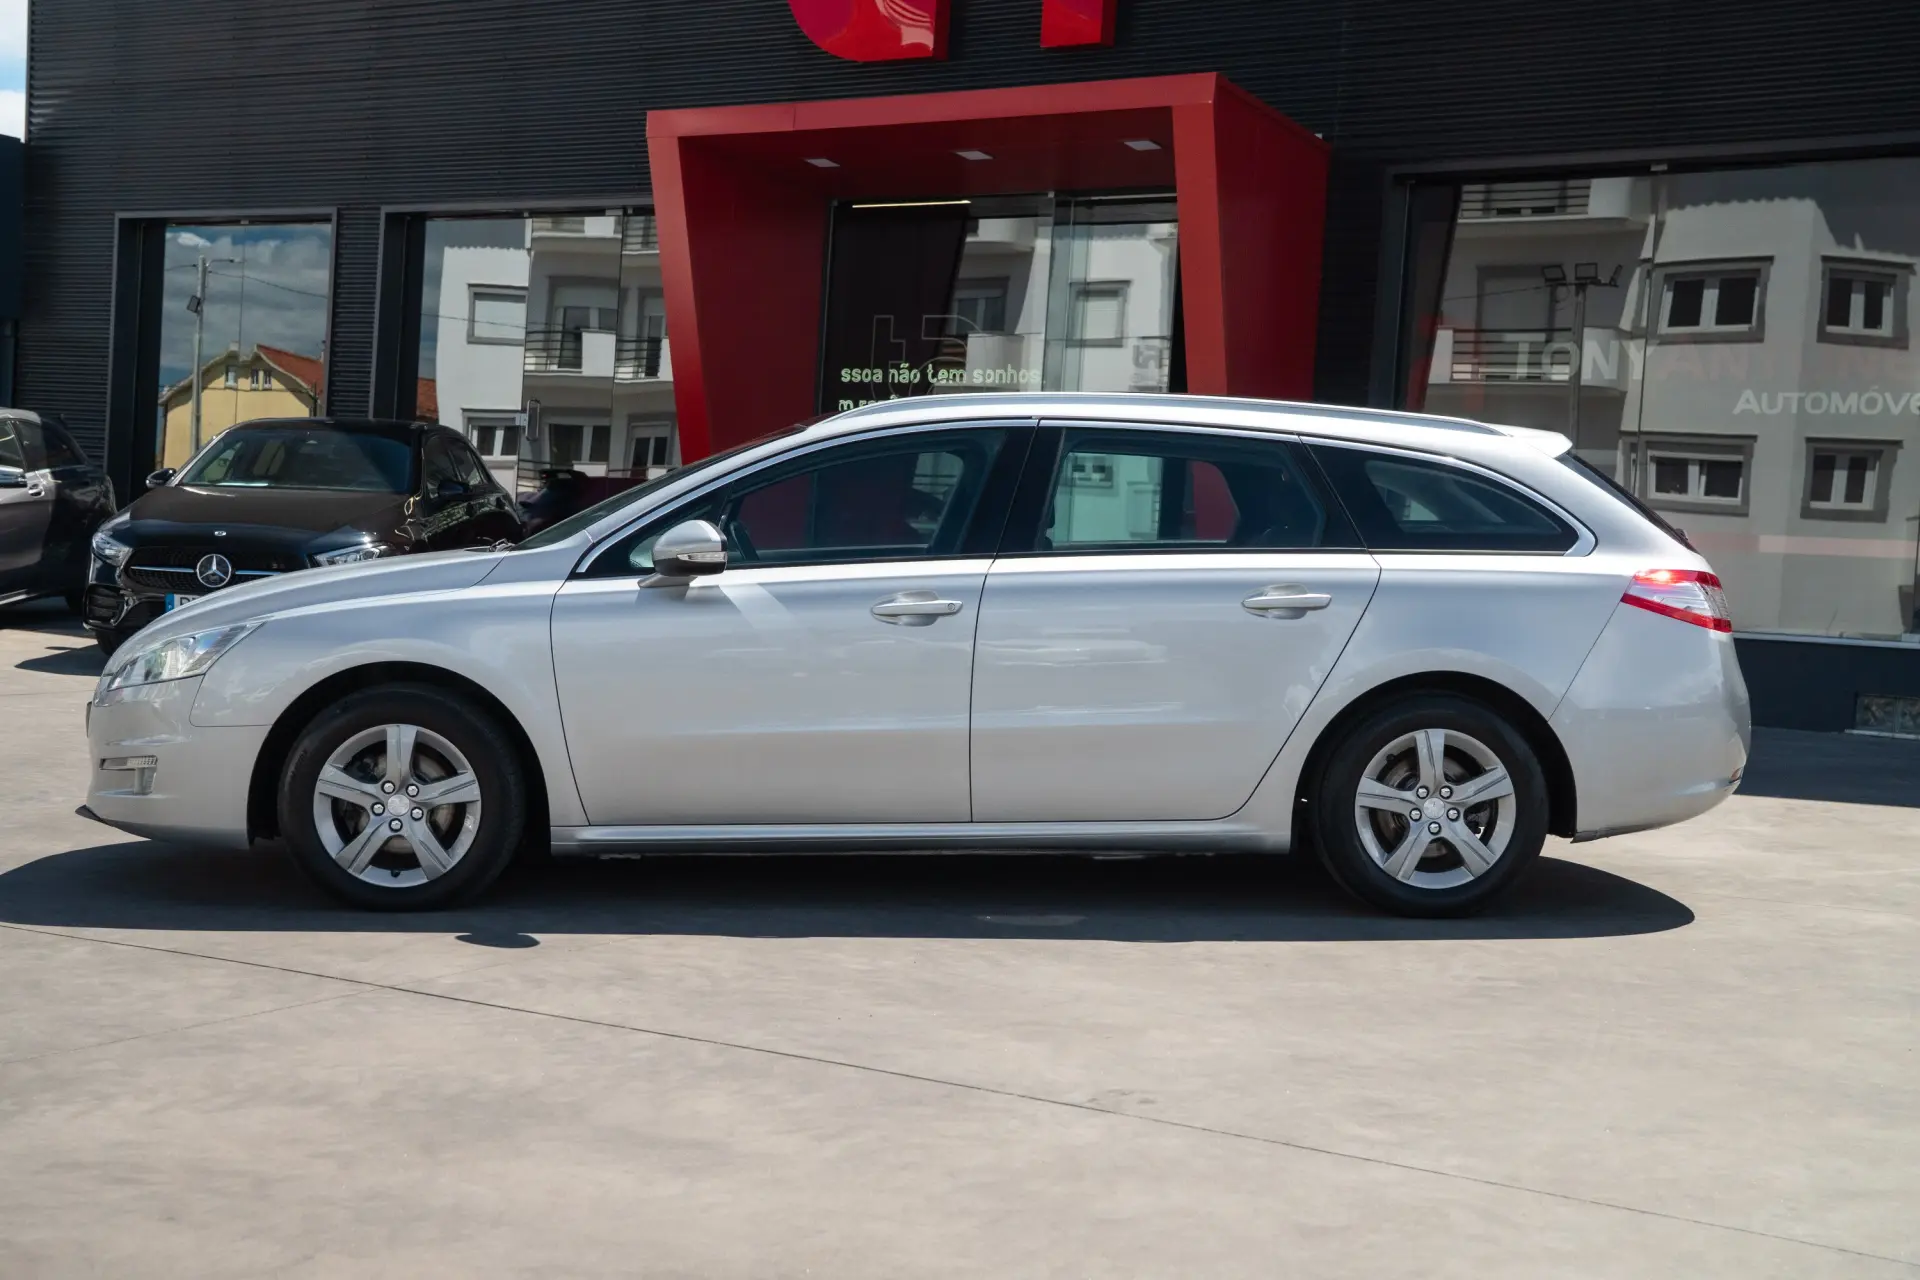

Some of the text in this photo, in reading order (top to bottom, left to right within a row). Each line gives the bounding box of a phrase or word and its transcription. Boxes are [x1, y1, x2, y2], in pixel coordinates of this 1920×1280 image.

[840, 367, 883, 383] ssoa
[888, 362, 921, 383] não
[926, 363, 967, 384] tem
[1503, 332, 1659, 381] TONY
